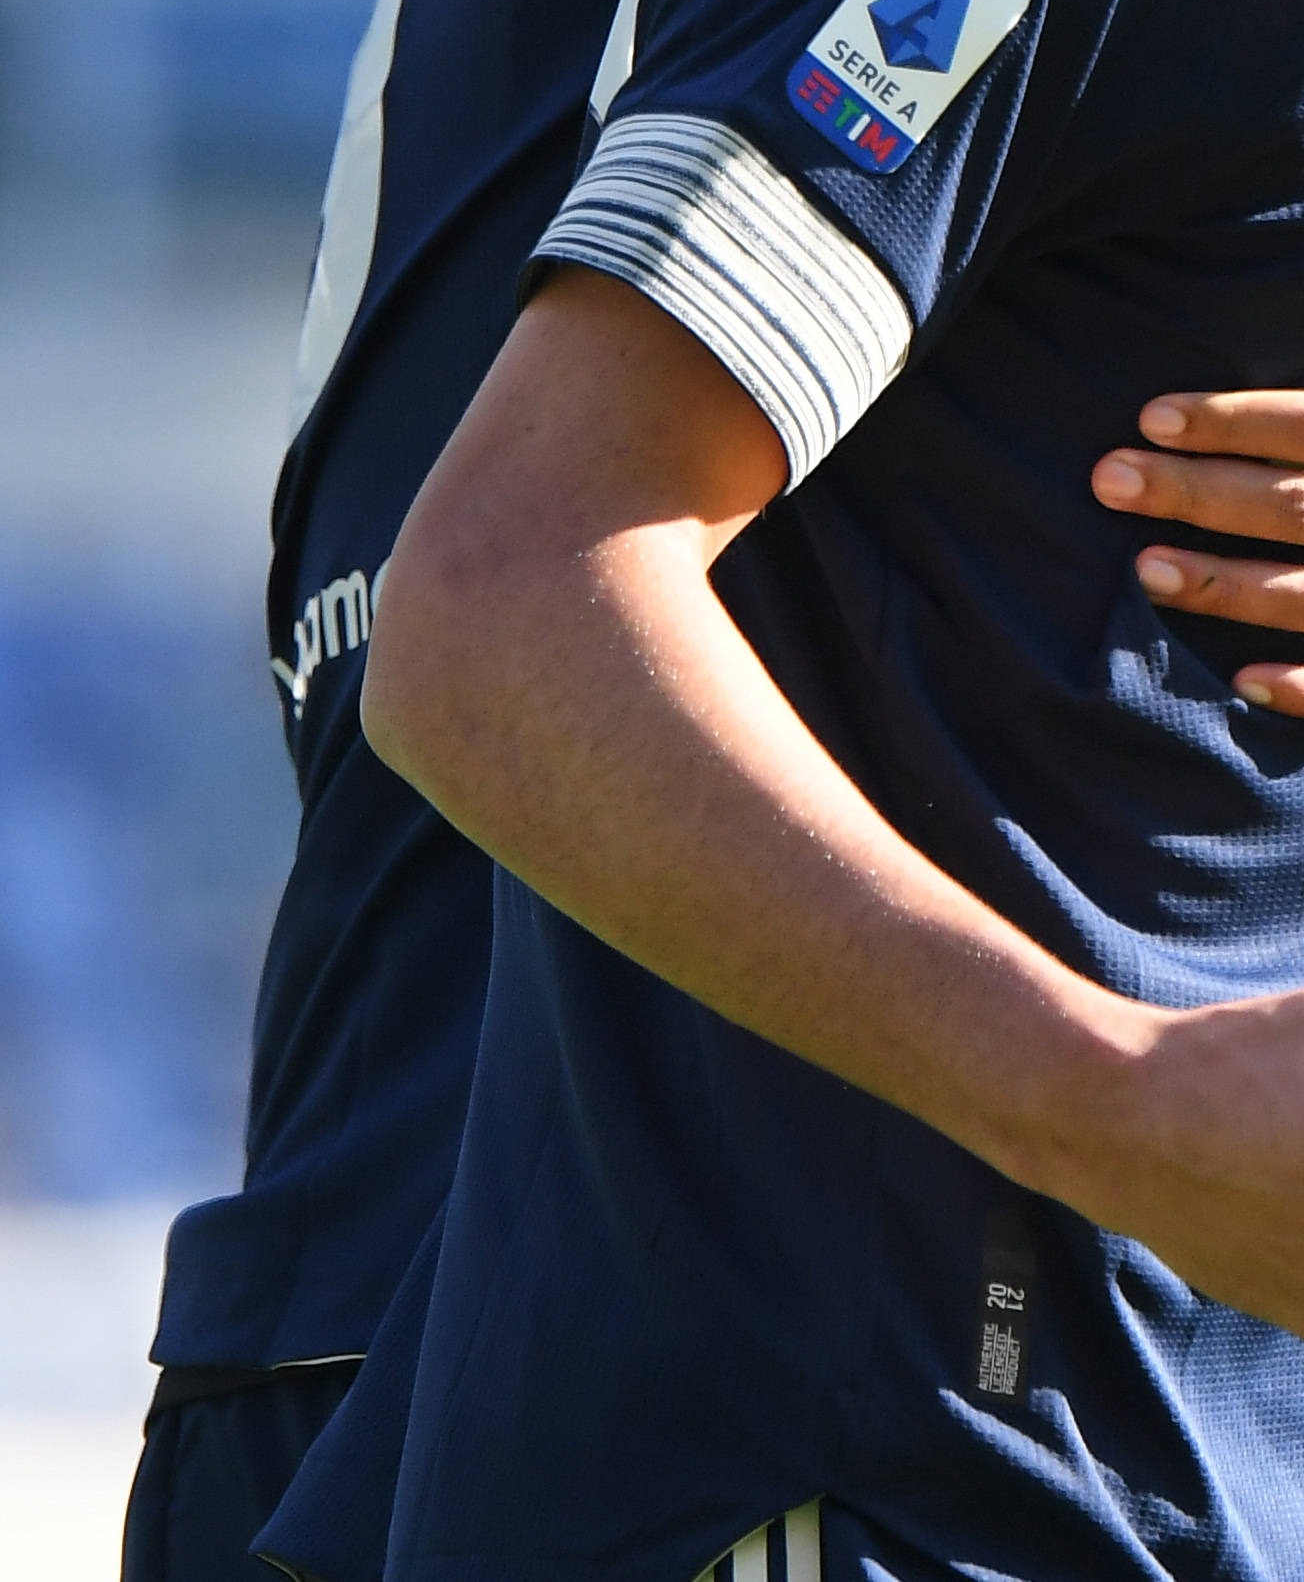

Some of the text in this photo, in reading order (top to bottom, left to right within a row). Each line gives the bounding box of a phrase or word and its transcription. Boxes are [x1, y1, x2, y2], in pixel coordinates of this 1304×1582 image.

[827, 38, 921, 125] SERIE A
[834, 97, 897, 162] TIM
[987, 1284, 1006, 1309] 20
[1007, 1287, 1025, 1310] 21
[978, 1324, 995, 1390] AUTHENTIC
[992, 1333, 1008, 1393] LICENSED
[1006, 1339, 1021, 1395] PRODUCT
